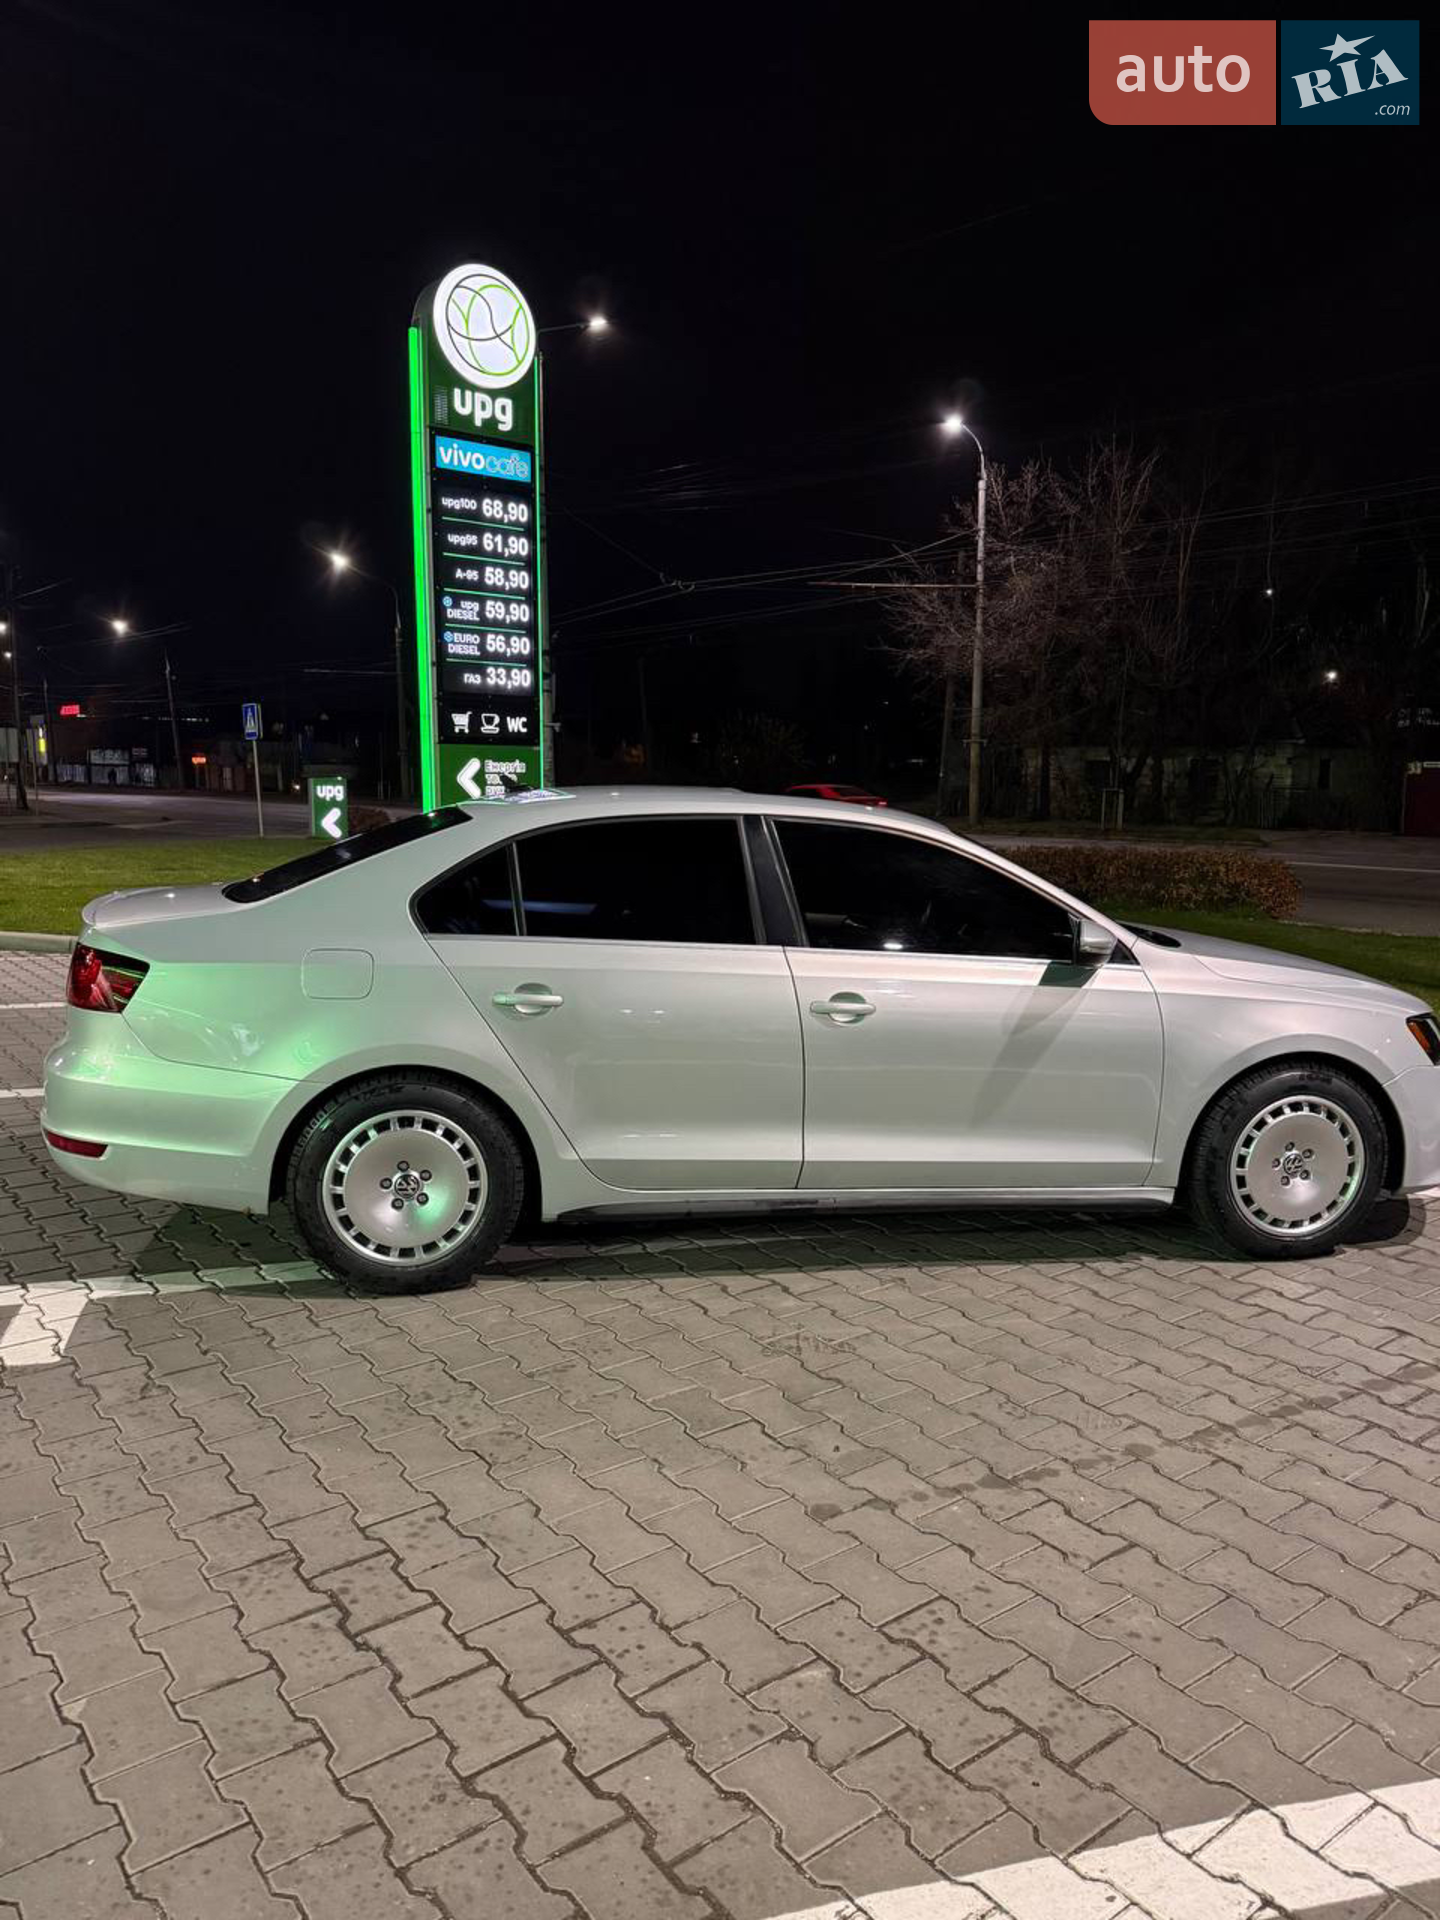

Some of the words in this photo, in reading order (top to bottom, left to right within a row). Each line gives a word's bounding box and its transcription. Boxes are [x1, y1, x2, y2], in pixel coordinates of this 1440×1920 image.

[453, 387, 513, 431] upg
[442, 497, 477, 510] upg100
[482, 498, 529, 523] 68,90
[447, 534, 478, 546] upg95
[483, 532, 529, 557] 61,90
[484, 566, 530, 590] 58,90
[446, 608, 480, 621] DIESEL
[460, 601, 479, 612] upg
[485, 600, 530, 624] 59,90
[447, 643, 481, 656] DIESEL
[454, 632, 480, 645] EURO
[486, 634, 531, 657] 56,90
[463, 673, 481, 685] ГАЗ
[486, 667, 532, 690] 33,90
[506, 716, 527, 733] WC
[316, 785, 344, 801] upg
